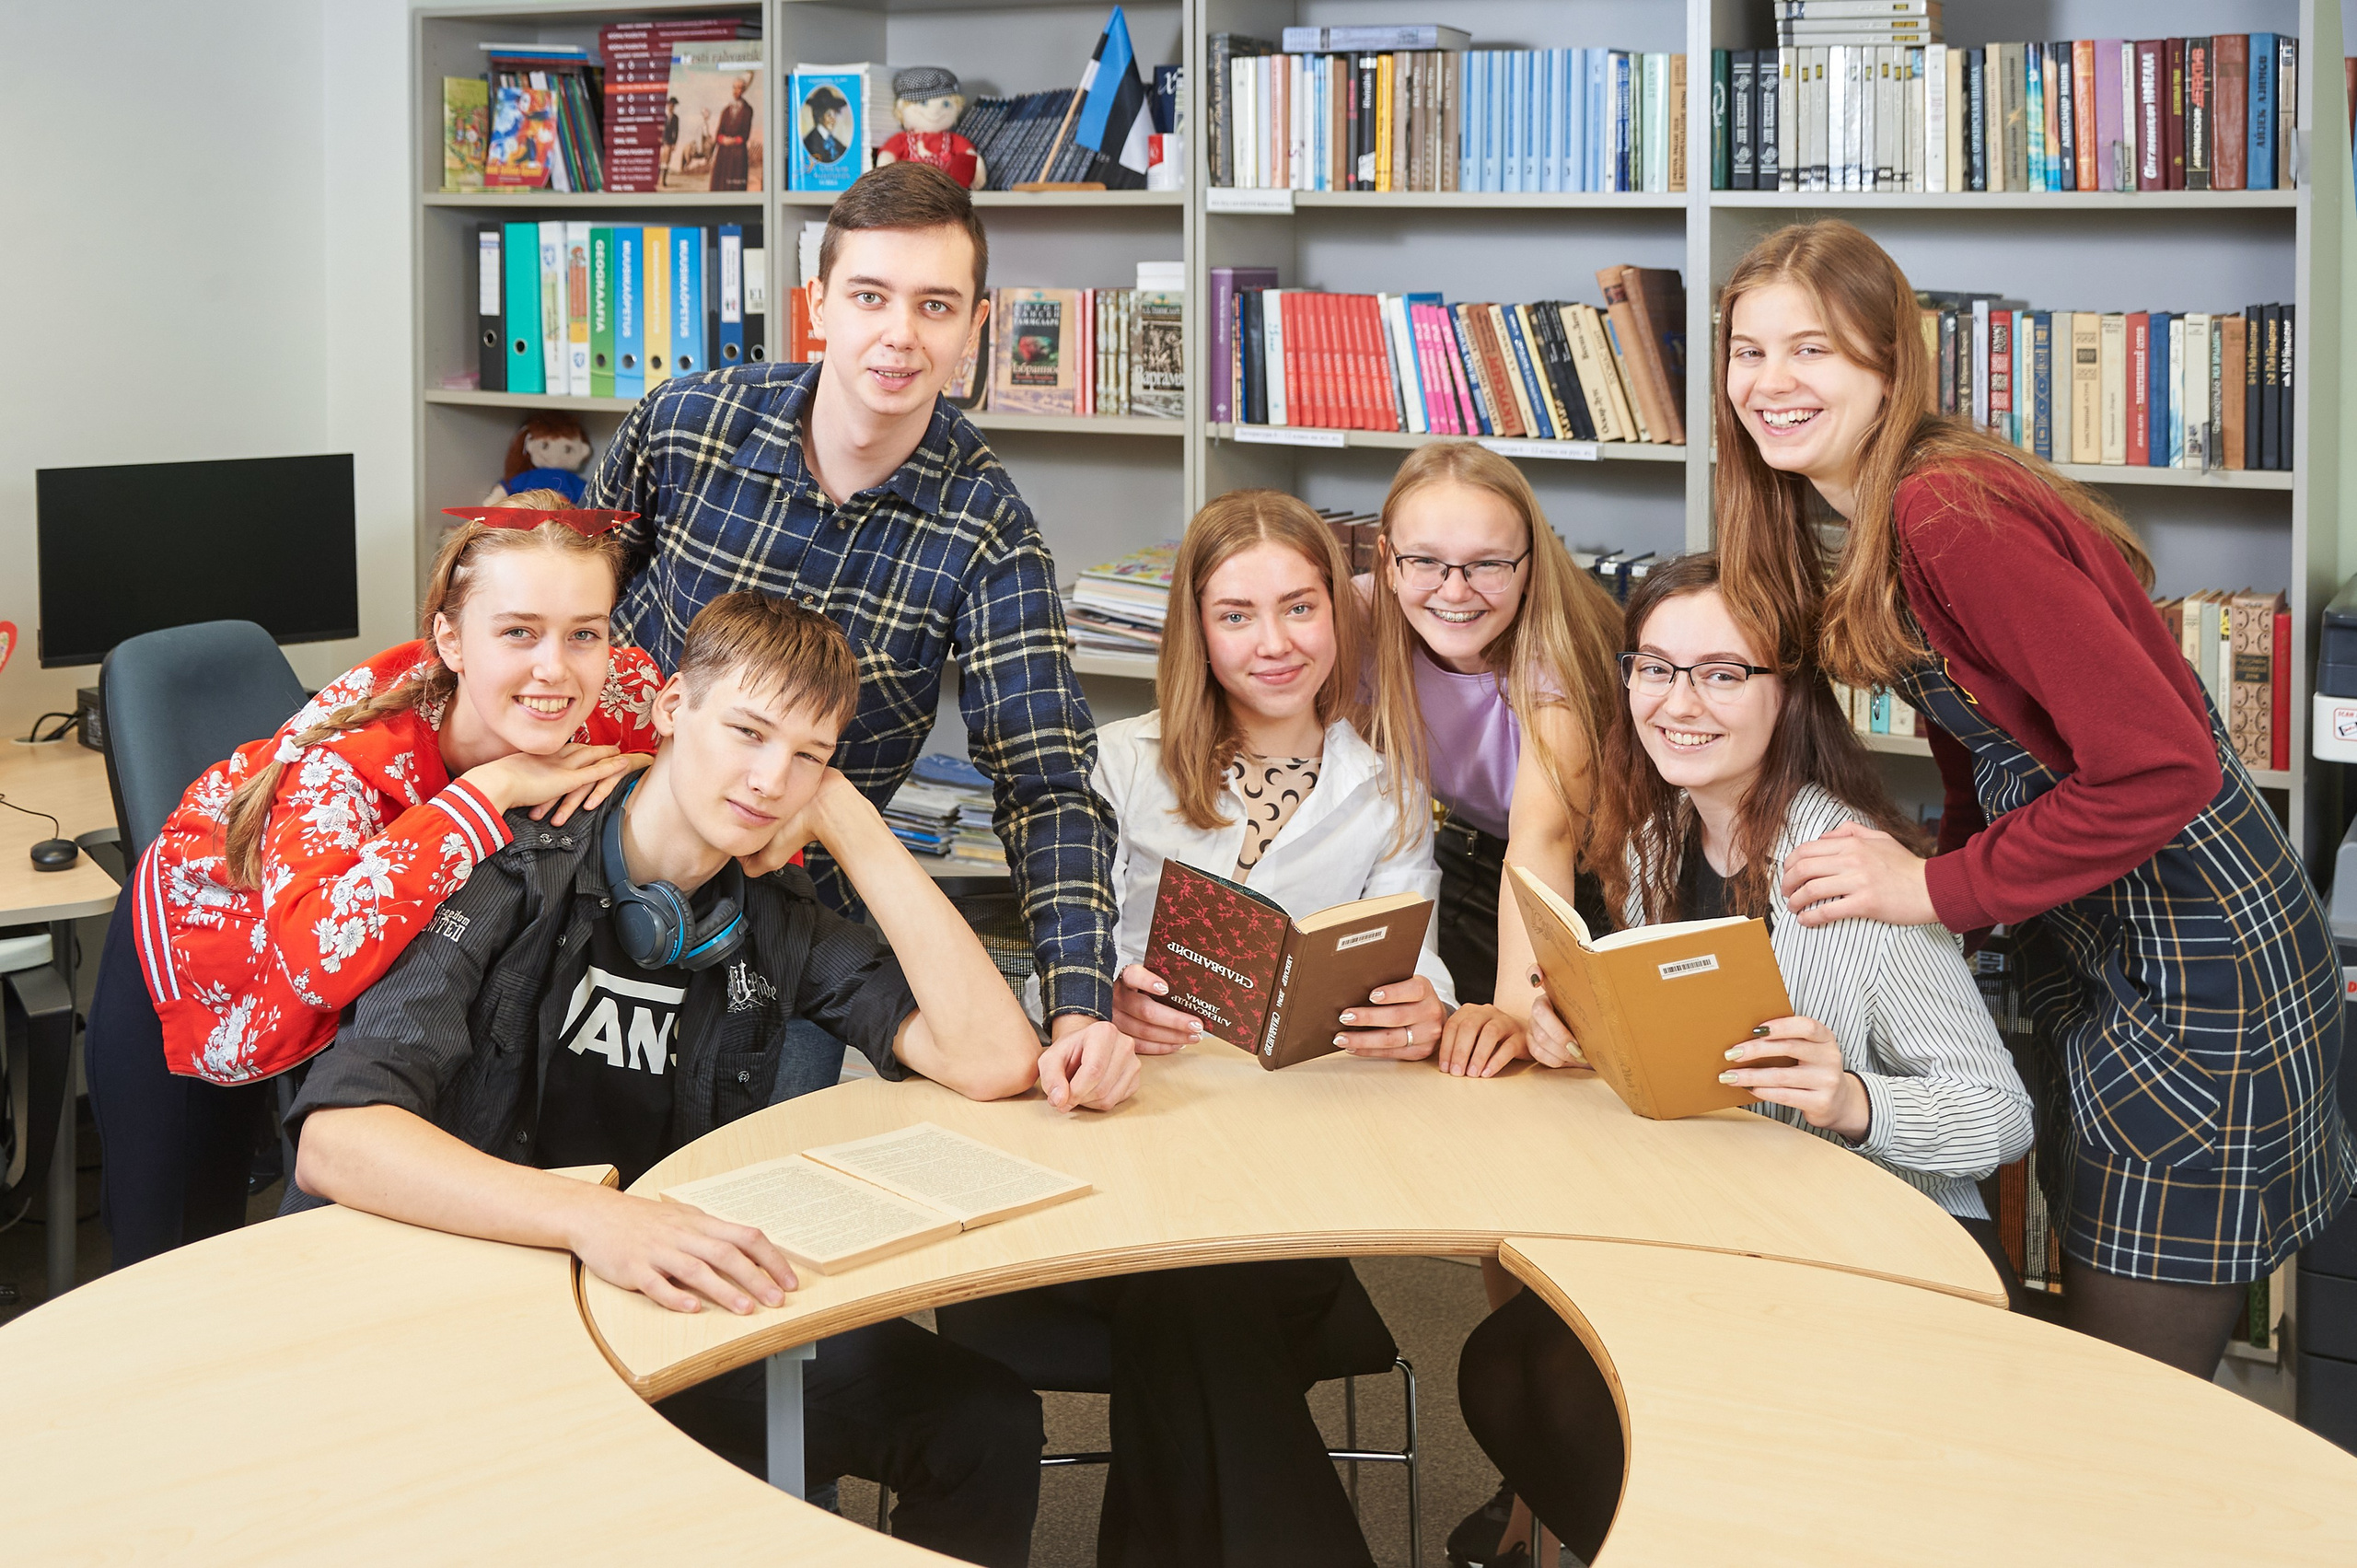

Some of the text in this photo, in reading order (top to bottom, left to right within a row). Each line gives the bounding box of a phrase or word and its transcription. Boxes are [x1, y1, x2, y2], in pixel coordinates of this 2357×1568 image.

[2060, 63, 2070, 96] БЕЛЯЕВ
[2254, 55, 2267, 149] АЙЗЕК АЗИМОВ
[2061, 96, 2071, 148] АЛЕКСАНДР
[595, 239, 605, 333] GEOGRAAFIA
[621, 239, 633, 338] MUUSIKAÕPETUS
[679, 239, 691, 338] MUUSIKAÕPETUS
[1487, 355, 1515, 431] П.КУУСБЕРГ
[1283, 953, 1294, 987] АЛЕКСАНДР
[1171, 993, 1232, 1028] АЛЕКСАНДР
[1186, 993, 1220, 1014] ДЮМА
[1276, 988, 1285, 1008] ДЮМА
